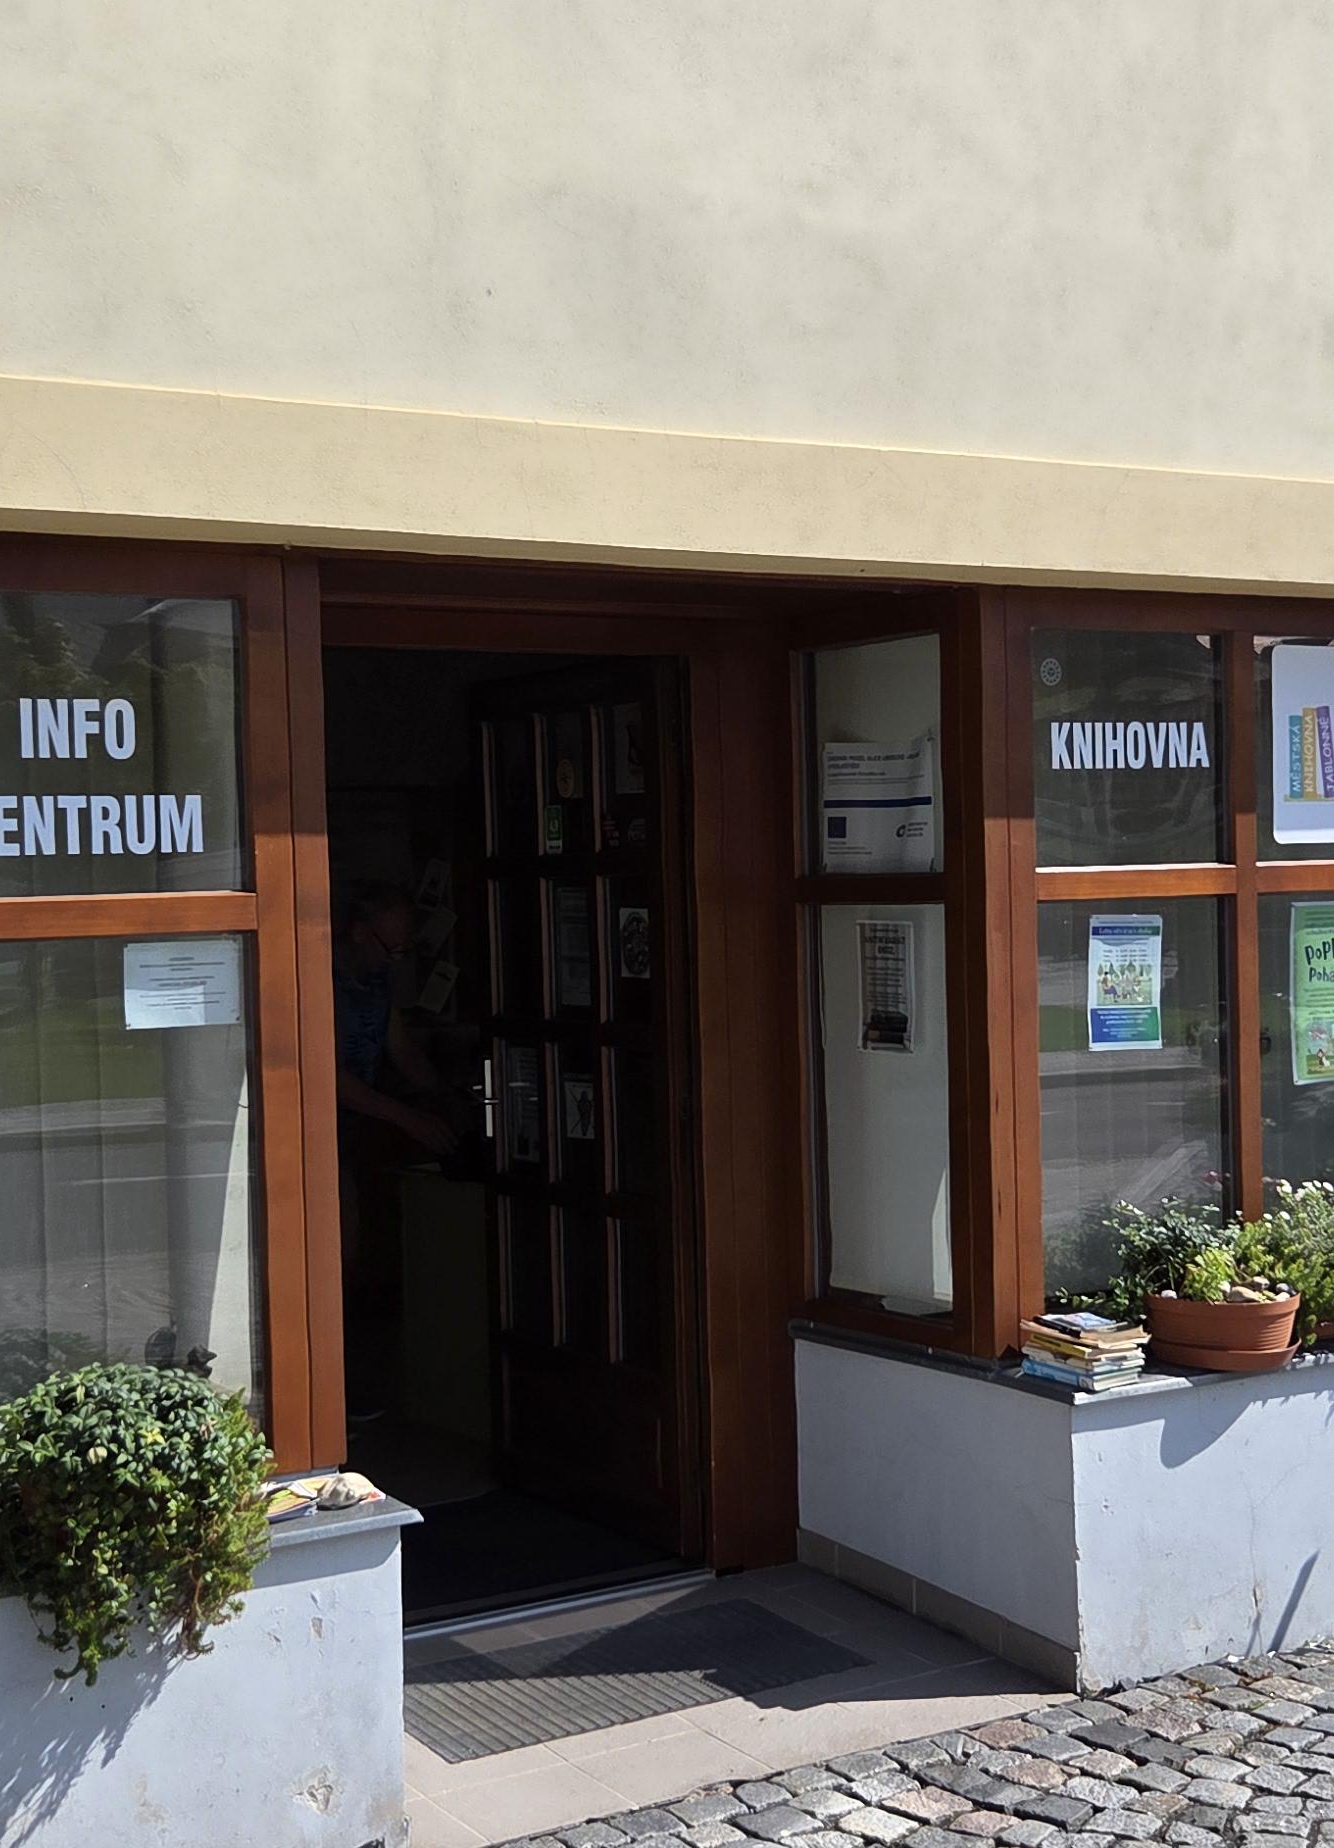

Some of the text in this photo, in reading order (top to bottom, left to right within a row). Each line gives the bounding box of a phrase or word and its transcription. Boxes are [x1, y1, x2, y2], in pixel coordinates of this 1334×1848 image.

[19, 697, 136, 760] INFO
[1050, 720, 1210, 770] KNIHOVNA
[1303, 715, 1314, 793] KNIHOVNA
